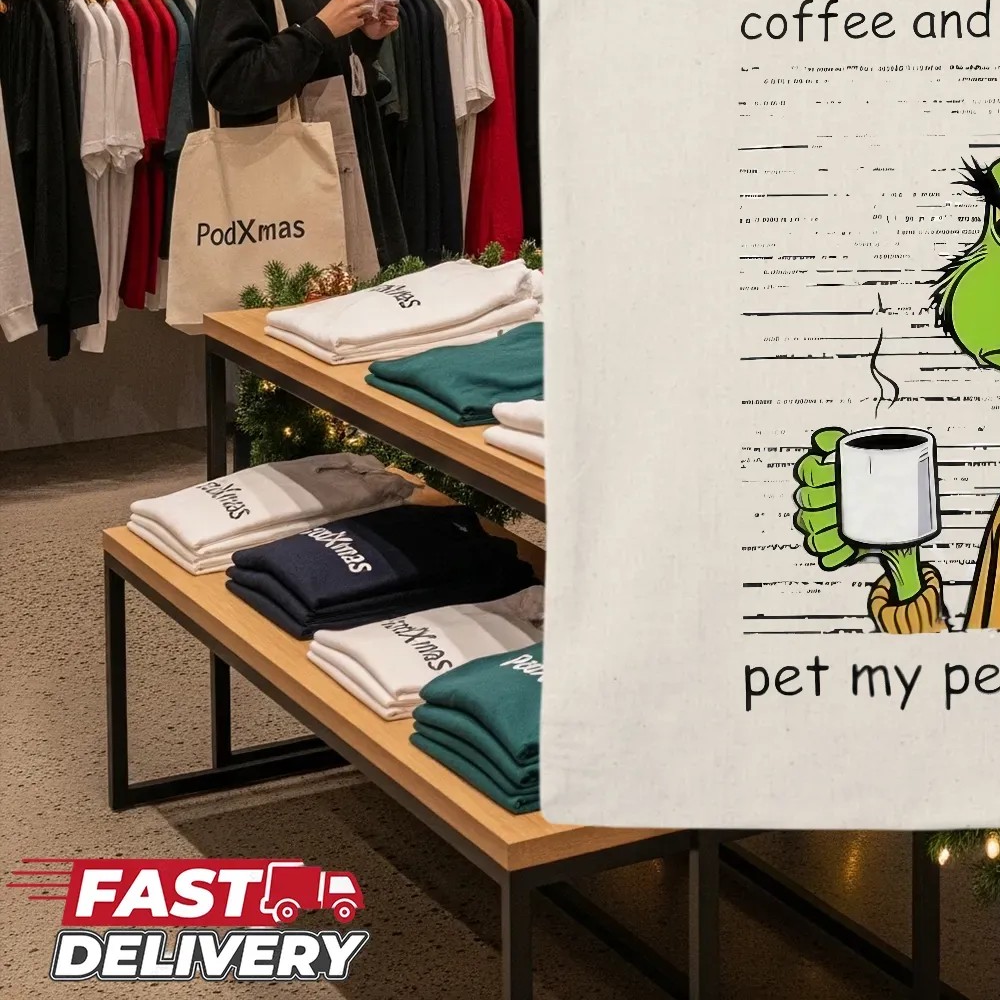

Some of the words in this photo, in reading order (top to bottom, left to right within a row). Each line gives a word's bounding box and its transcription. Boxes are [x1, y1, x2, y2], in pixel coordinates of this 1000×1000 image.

[196, 217, 306, 247] PodXmas
[744, 655, 830, 712] pet
[851, 663, 922, 711] my
